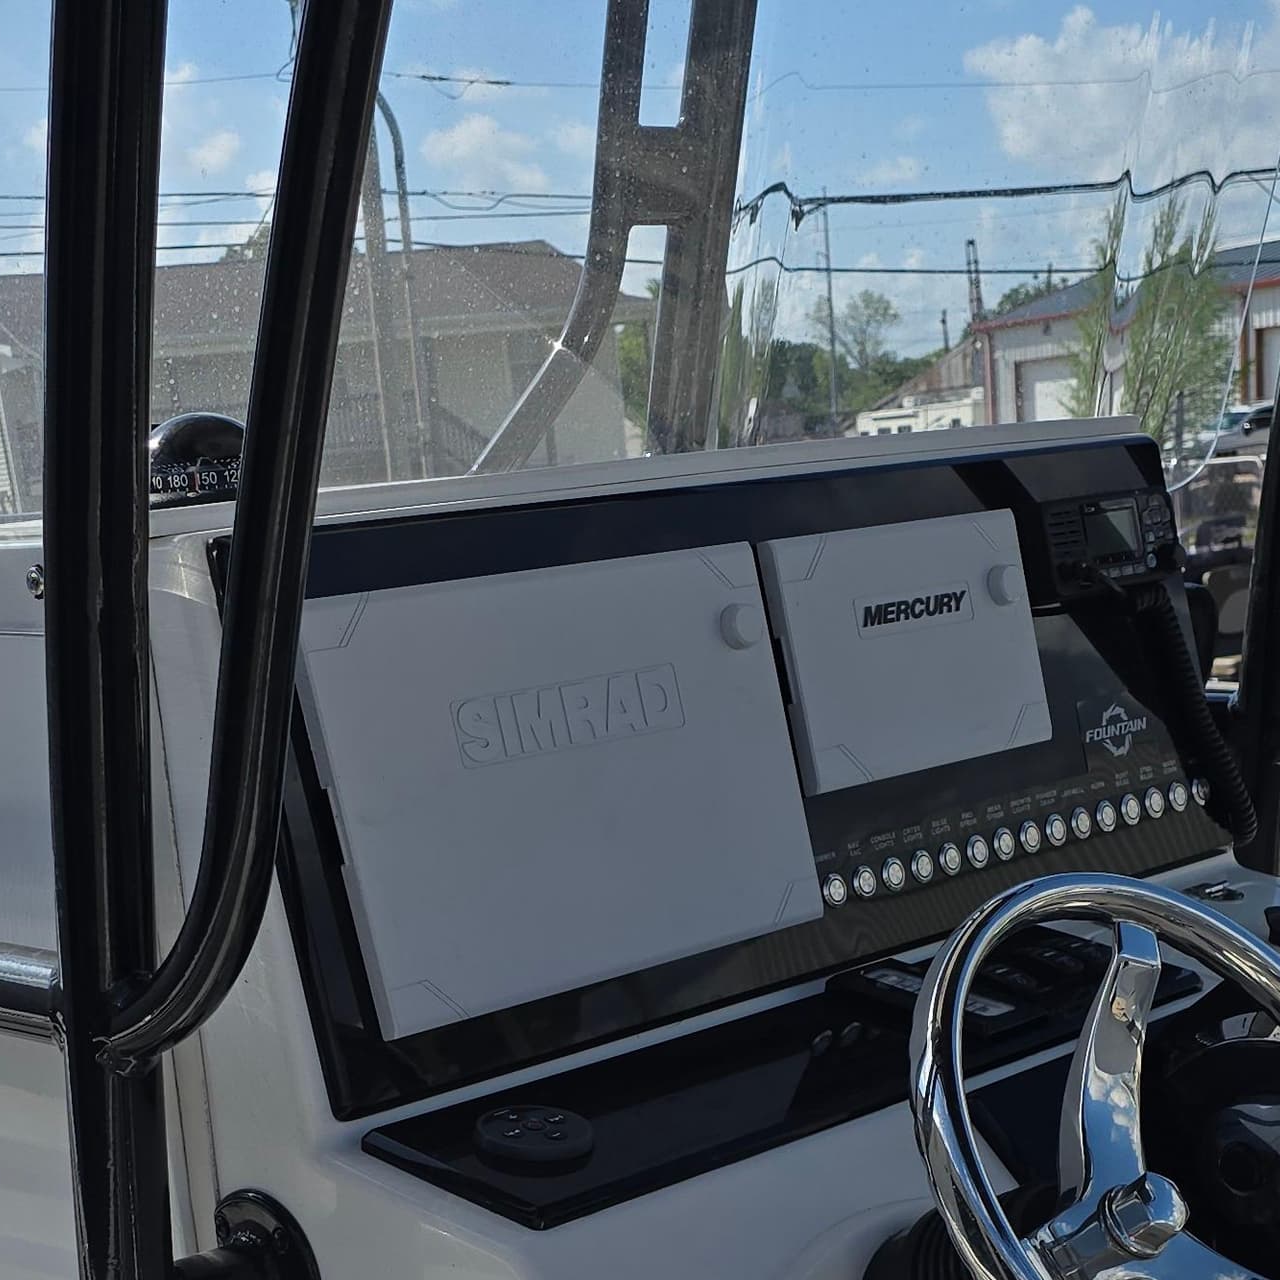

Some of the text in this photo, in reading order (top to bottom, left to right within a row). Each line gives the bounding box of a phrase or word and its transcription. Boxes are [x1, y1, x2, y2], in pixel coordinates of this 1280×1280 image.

[167, 474, 188, 488] 180
[863, 589, 967, 628] MERCURY
[456, 667, 683, 764] SIMRAD
[1085, 717, 1147, 743] FOUNTAIN
